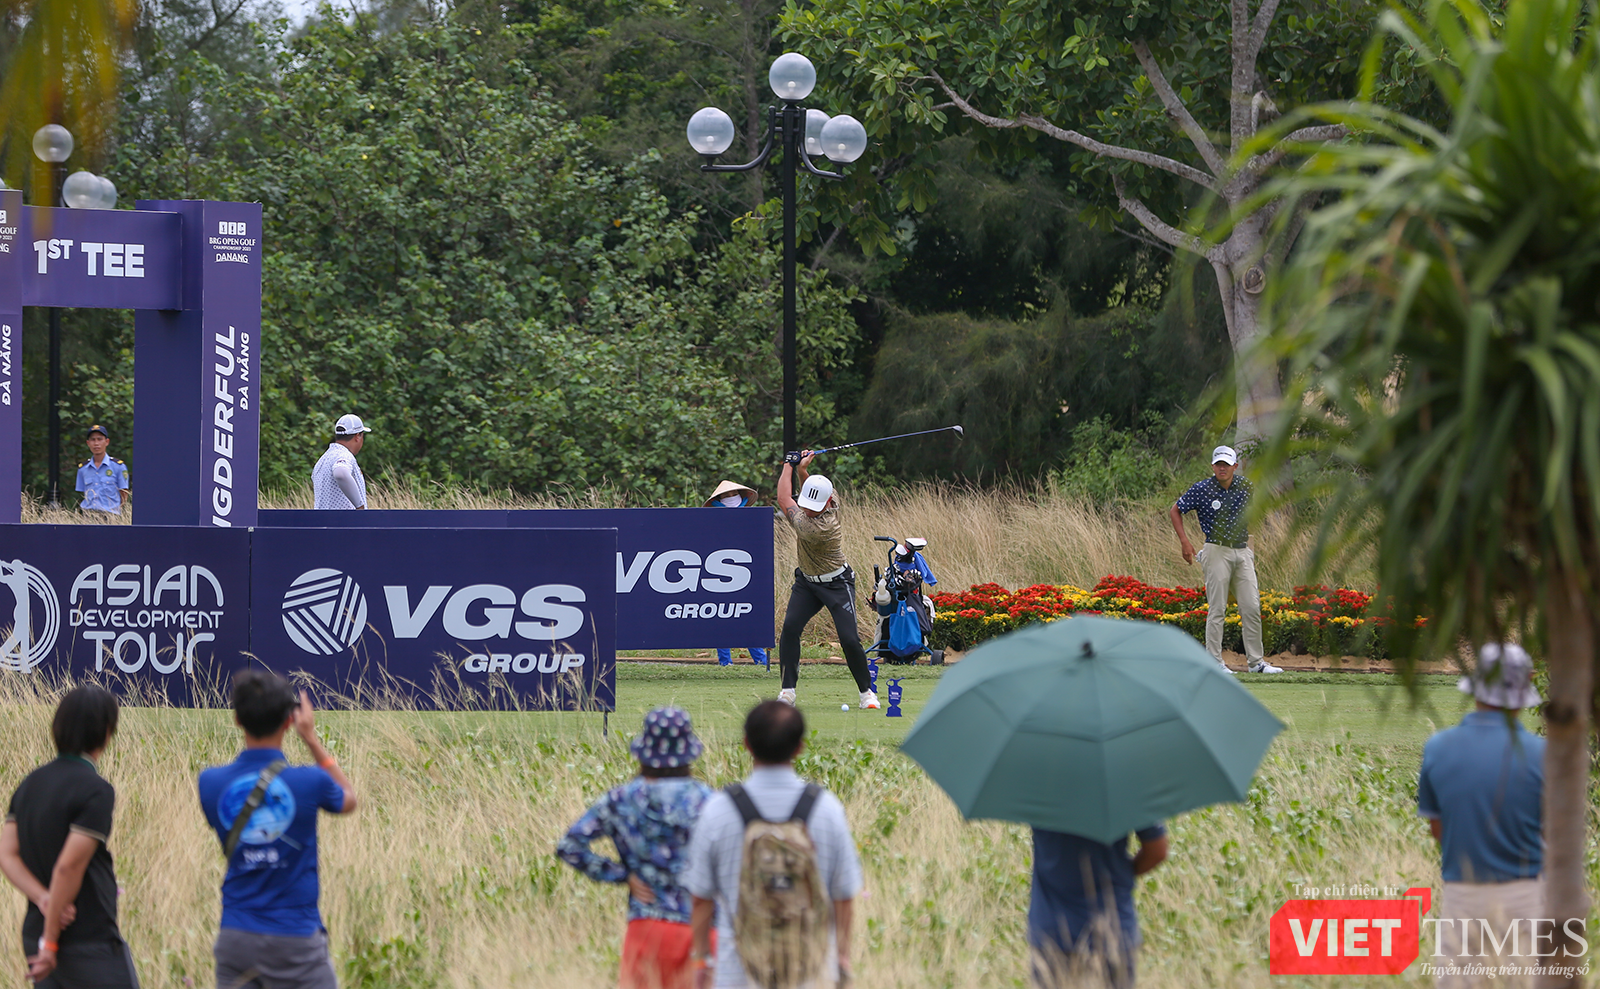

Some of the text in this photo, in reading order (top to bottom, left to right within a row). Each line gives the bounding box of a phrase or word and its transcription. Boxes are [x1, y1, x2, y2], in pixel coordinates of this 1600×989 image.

[33, 239, 145, 277] 1ST TEE
[216, 253, 249, 264] DANANG
[238, 386, 249, 410] ĐÀ
[70, 563, 225, 607] ASIAN
[616, 548, 753, 594] VGS
[69, 608, 224, 629] DEVELOPMENT
[383, 584, 586, 641] VGS
[664, 602, 753, 619] GROUP
[83, 631, 215, 675] TOUR
[464, 653, 586, 674] GROUP
